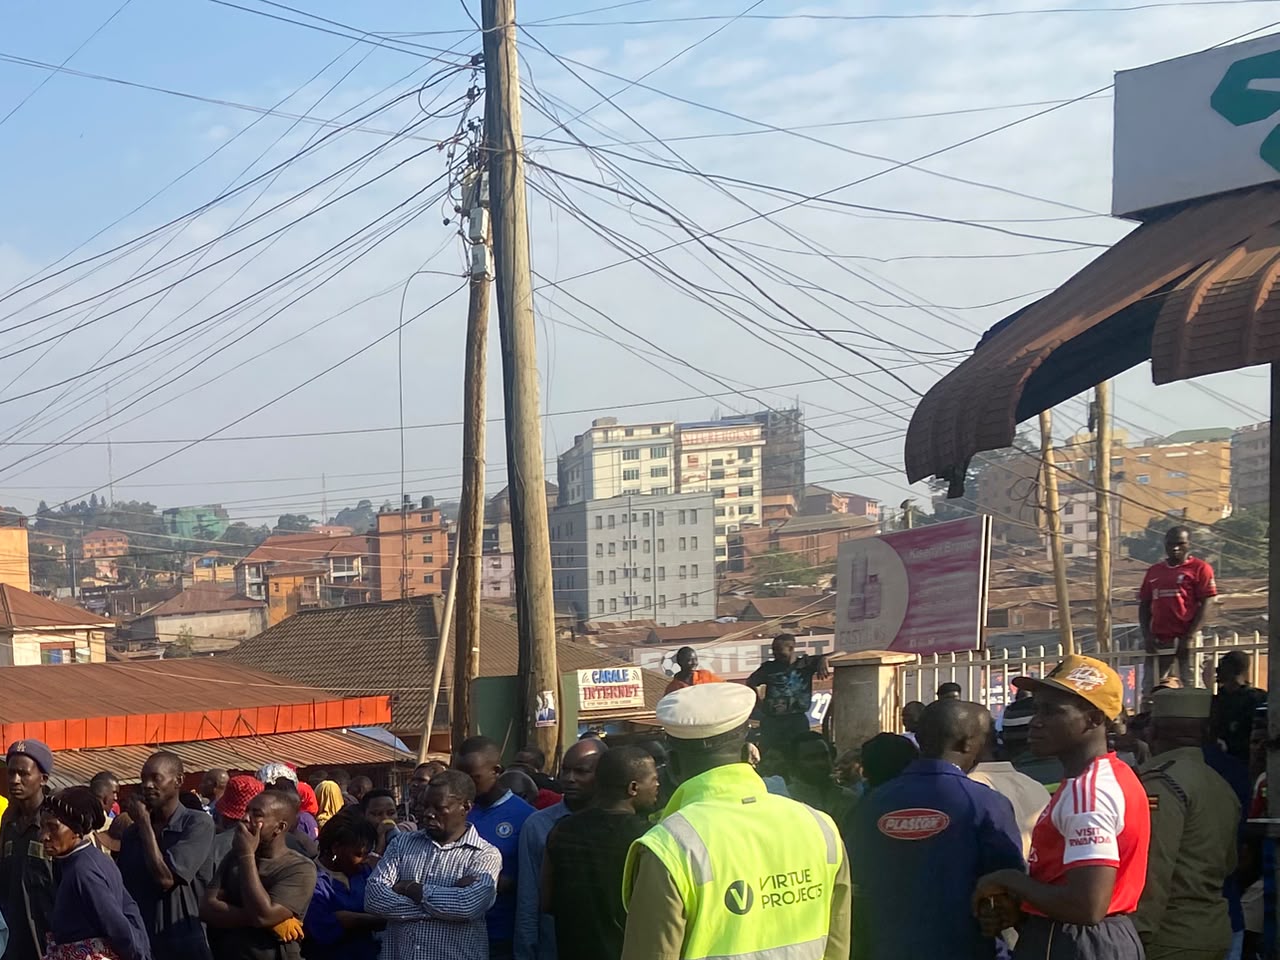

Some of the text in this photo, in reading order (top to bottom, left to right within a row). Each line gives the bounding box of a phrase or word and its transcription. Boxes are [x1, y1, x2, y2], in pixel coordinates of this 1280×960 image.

[583, 684, 639, 700] INTERNET
[1075, 827, 1101, 837] VISIT
[1069, 836, 1112, 847] RWANDA
[759, 869, 812, 891] VIRTUE
